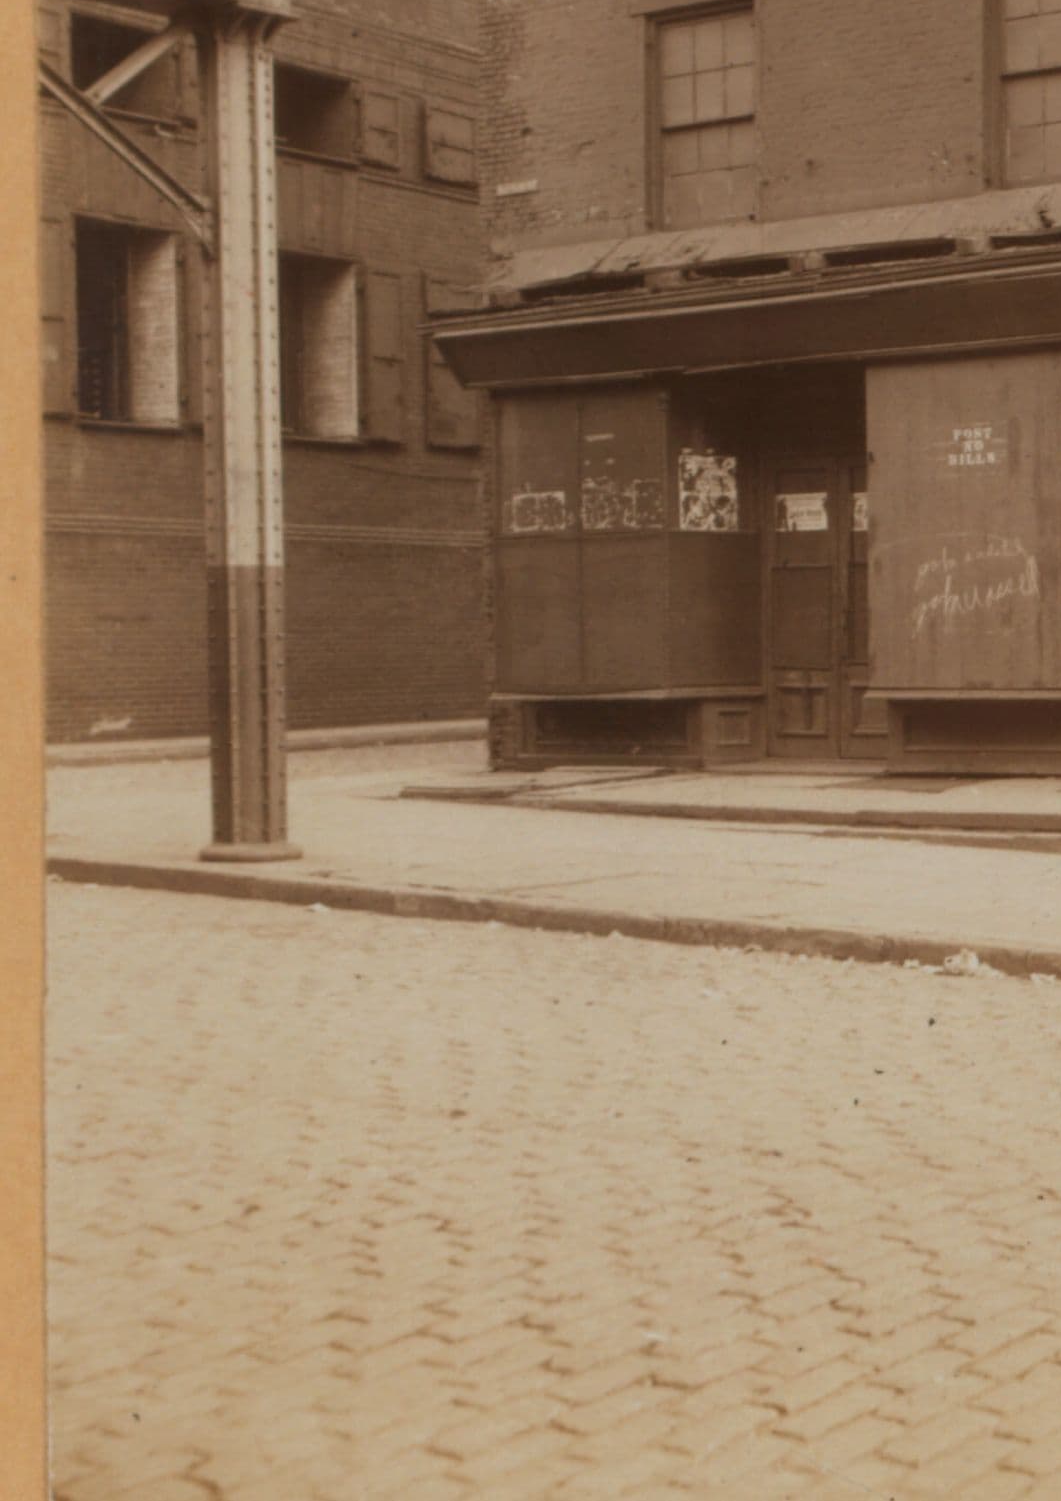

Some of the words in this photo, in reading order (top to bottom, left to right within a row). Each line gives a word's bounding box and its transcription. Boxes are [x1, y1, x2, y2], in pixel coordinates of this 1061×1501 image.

[952, 427, 992, 441] POST
[964, 440, 984, 452] NO
[948, 452, 995, 466] BILLS
